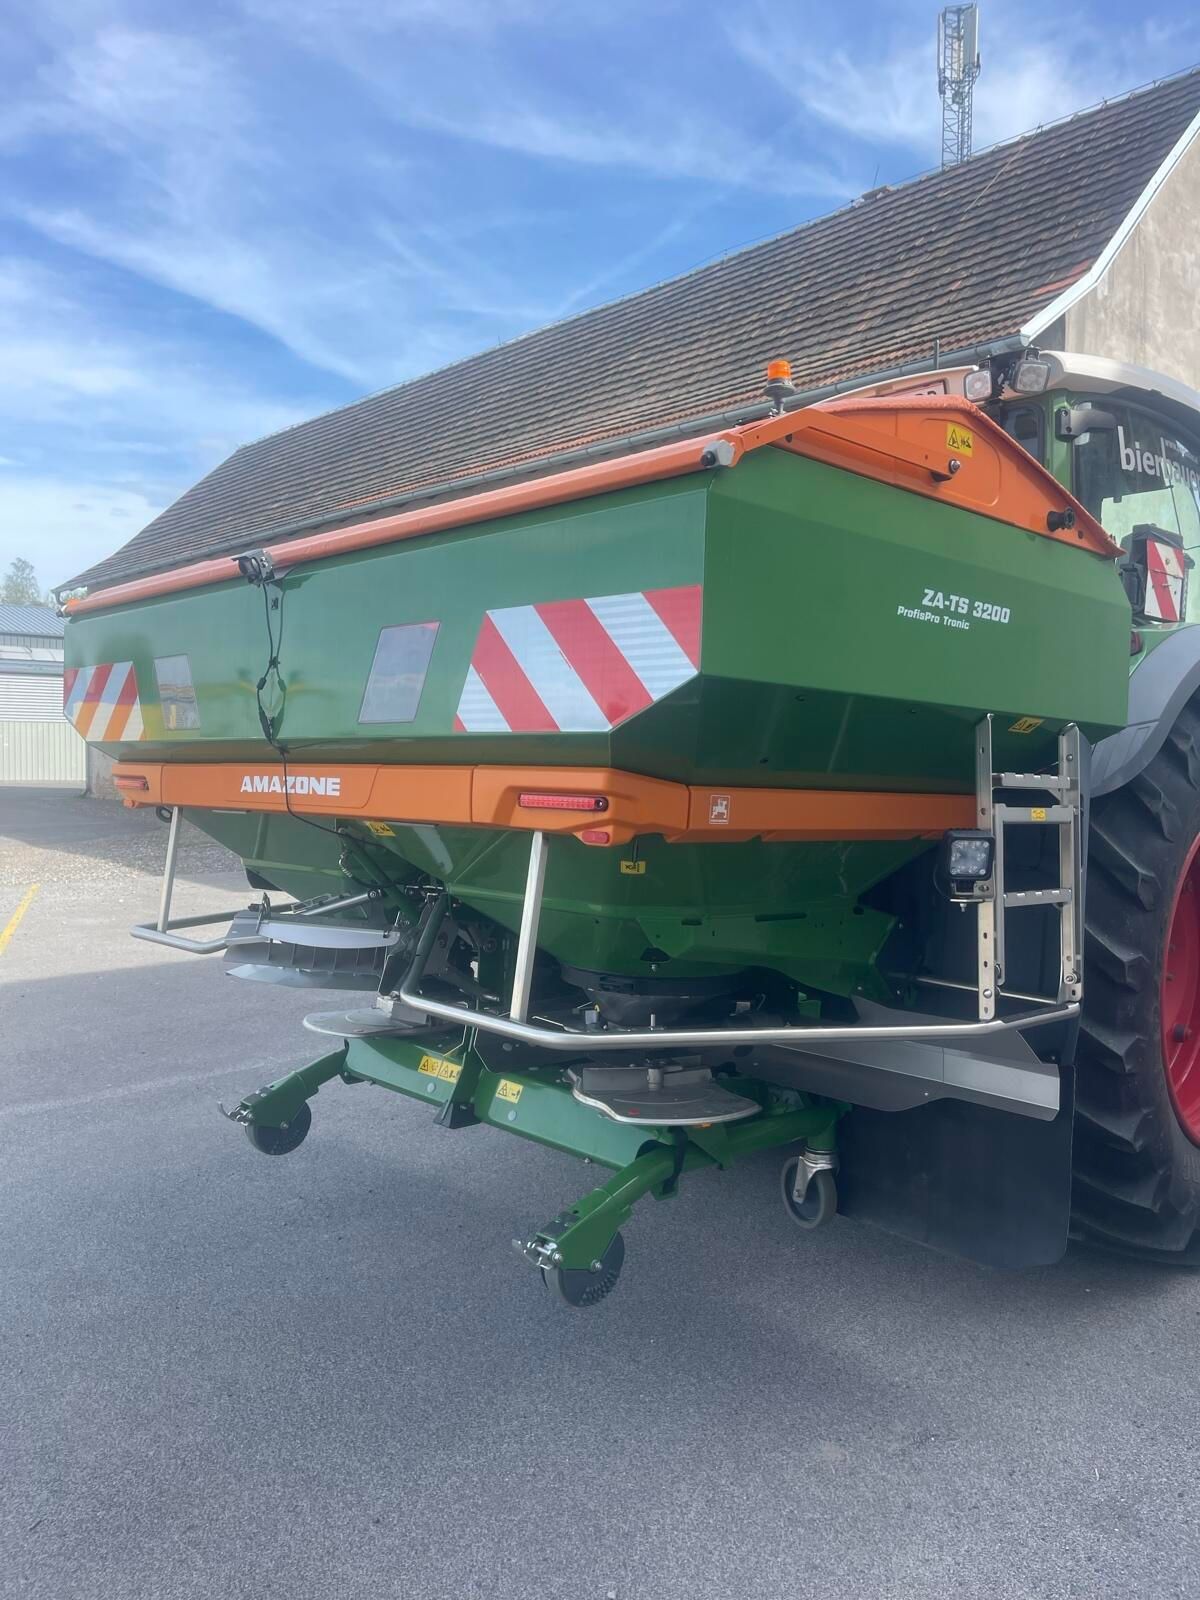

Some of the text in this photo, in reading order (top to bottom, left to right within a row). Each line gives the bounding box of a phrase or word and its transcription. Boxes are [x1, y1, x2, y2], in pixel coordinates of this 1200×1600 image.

[897, 605, 970, 630] ProfisPro Tronic
[922, 588, 1011, 624] ZA-TS 3200
[240, 775, 340, 796] AMAZONE
